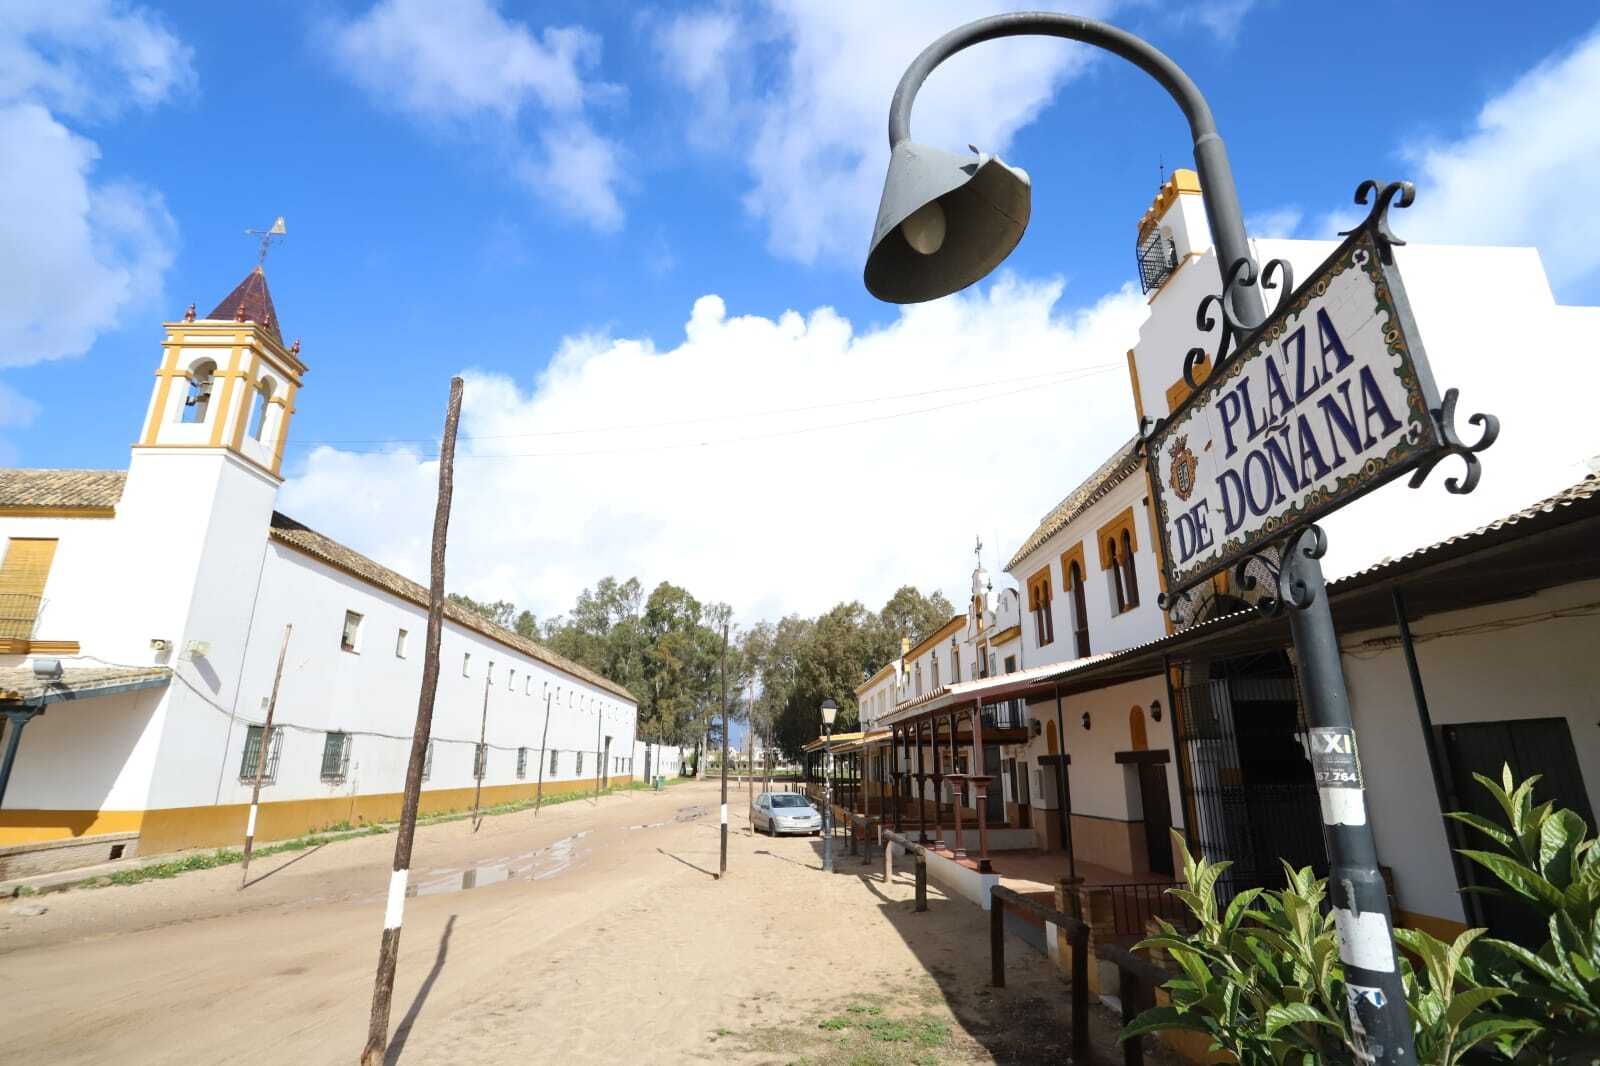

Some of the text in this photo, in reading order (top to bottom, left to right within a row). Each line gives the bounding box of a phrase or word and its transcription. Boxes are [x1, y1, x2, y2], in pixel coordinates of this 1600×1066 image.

[1174, 364, 1403, 564] DE DOÑANA
[1215, 306, 1354, 459] PLAZA
